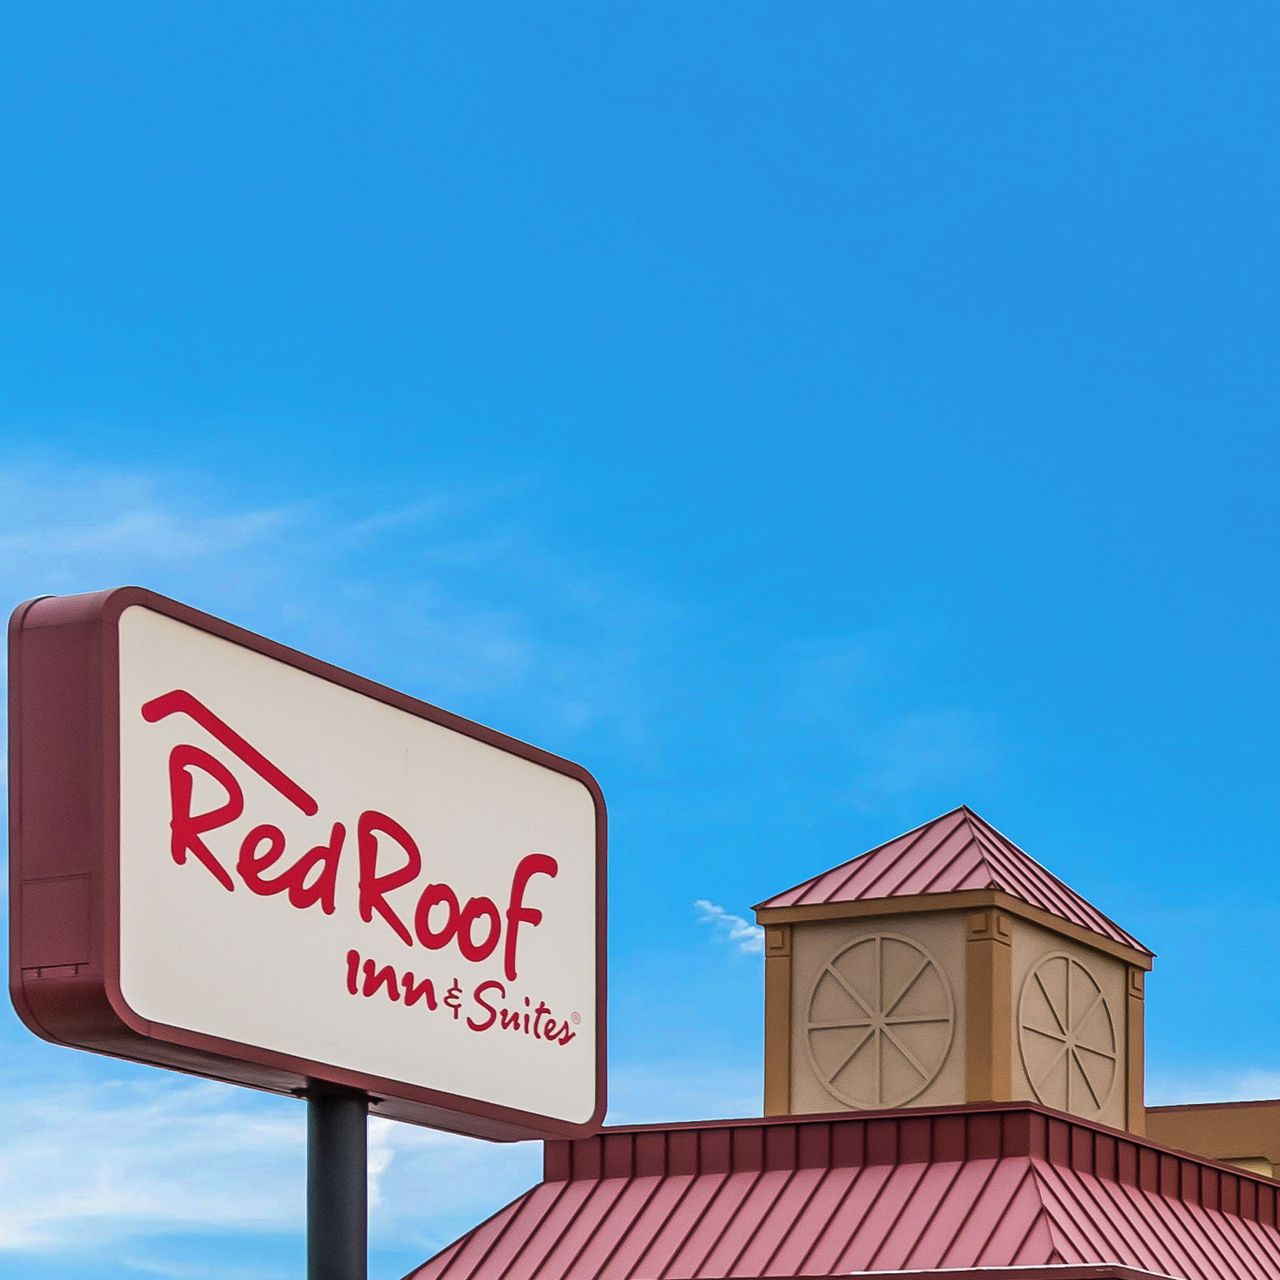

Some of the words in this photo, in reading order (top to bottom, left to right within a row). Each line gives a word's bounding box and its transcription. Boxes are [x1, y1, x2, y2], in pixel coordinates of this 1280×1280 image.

[168, 744, 347, 916] Red
[357, 810, 558, 982] Roof
[347, 950, 437, 1012] Inn
[444, 979, 461, 1019] &
